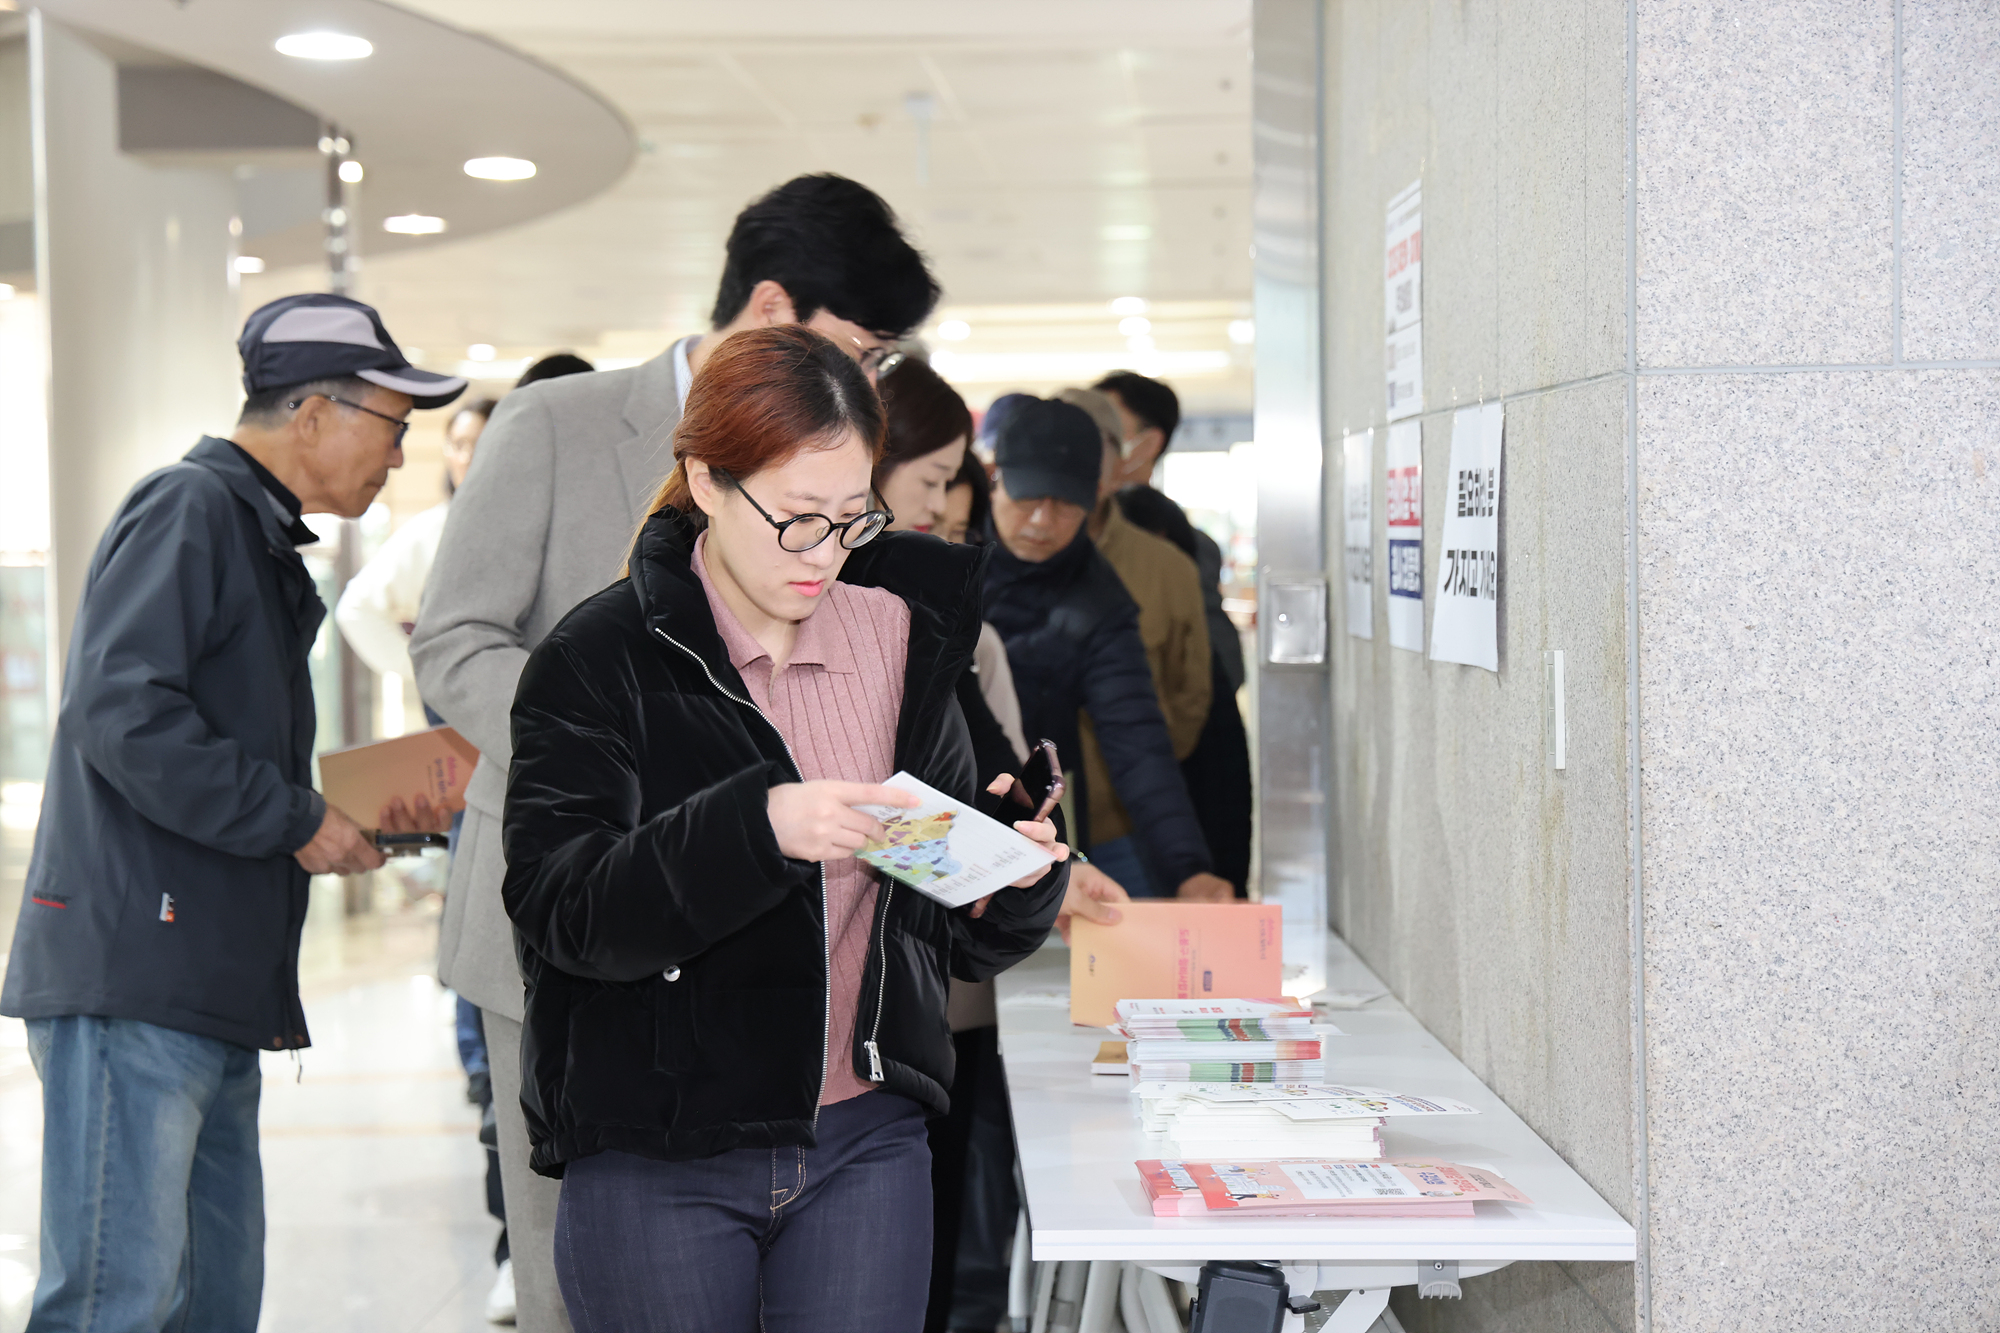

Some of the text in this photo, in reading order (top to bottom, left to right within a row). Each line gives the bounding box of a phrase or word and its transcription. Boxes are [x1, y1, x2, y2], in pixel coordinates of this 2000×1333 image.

[1457, 468, 1486, 518] 필요하신
[1487, 467, 1495, 518] 분
[1443, 549, 1478, 597] 가지고
[1480, 550, 1496, 601] 가세요
